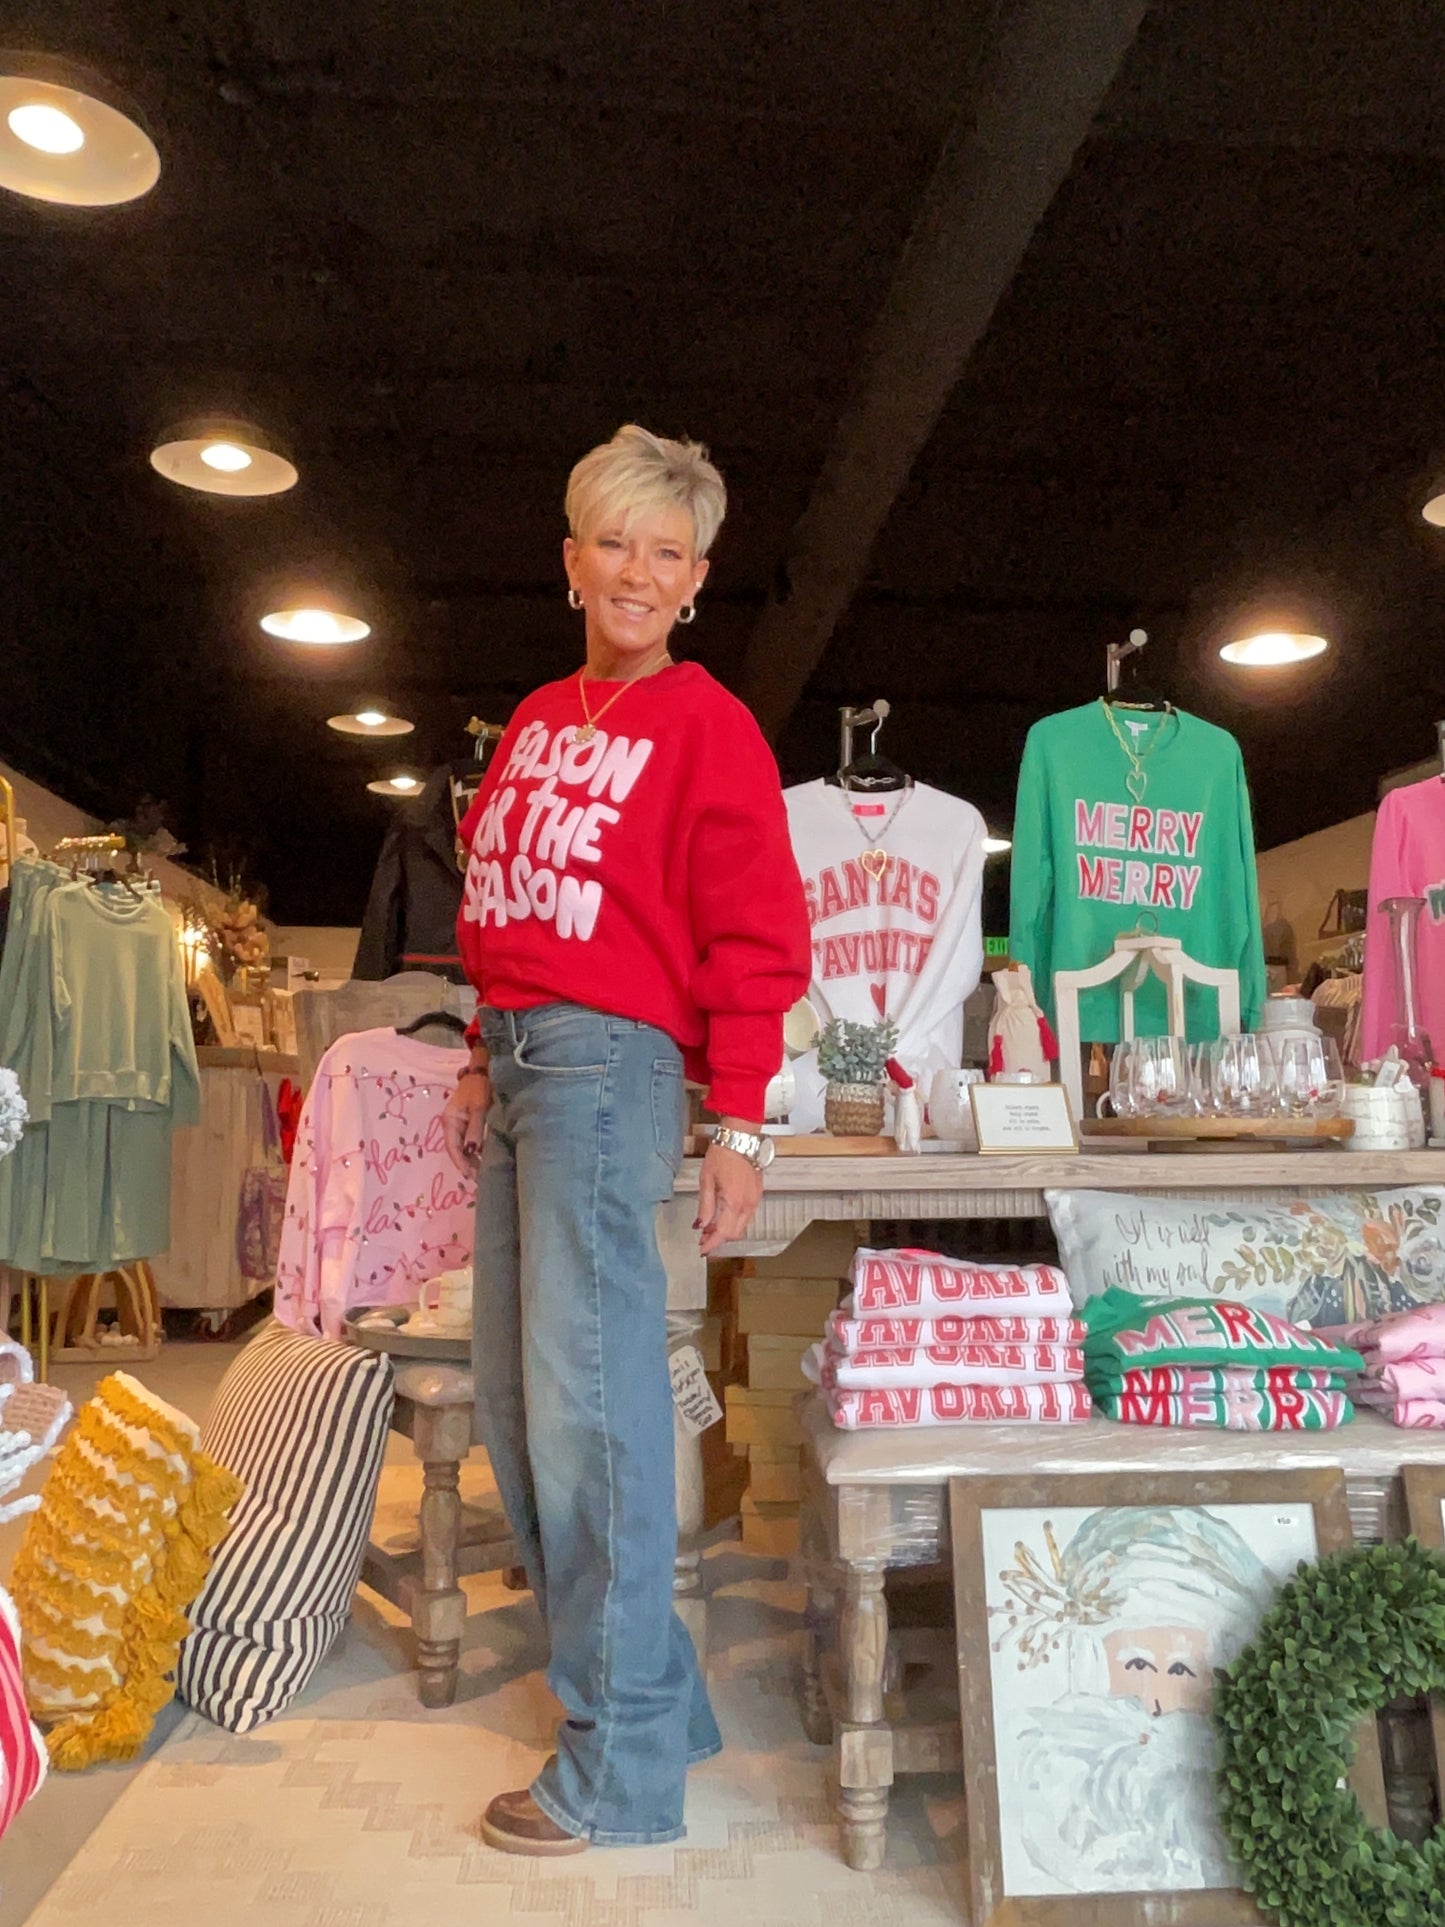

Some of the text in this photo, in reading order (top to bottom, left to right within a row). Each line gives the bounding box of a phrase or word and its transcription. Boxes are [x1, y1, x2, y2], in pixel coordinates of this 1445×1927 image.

[1075, 798, 1204, 858] MERRY
[463, 854, 602, 941] SEASON
[1076, 853, 1202, 910] MERRY
[366, 1196, 396, 1234] la
